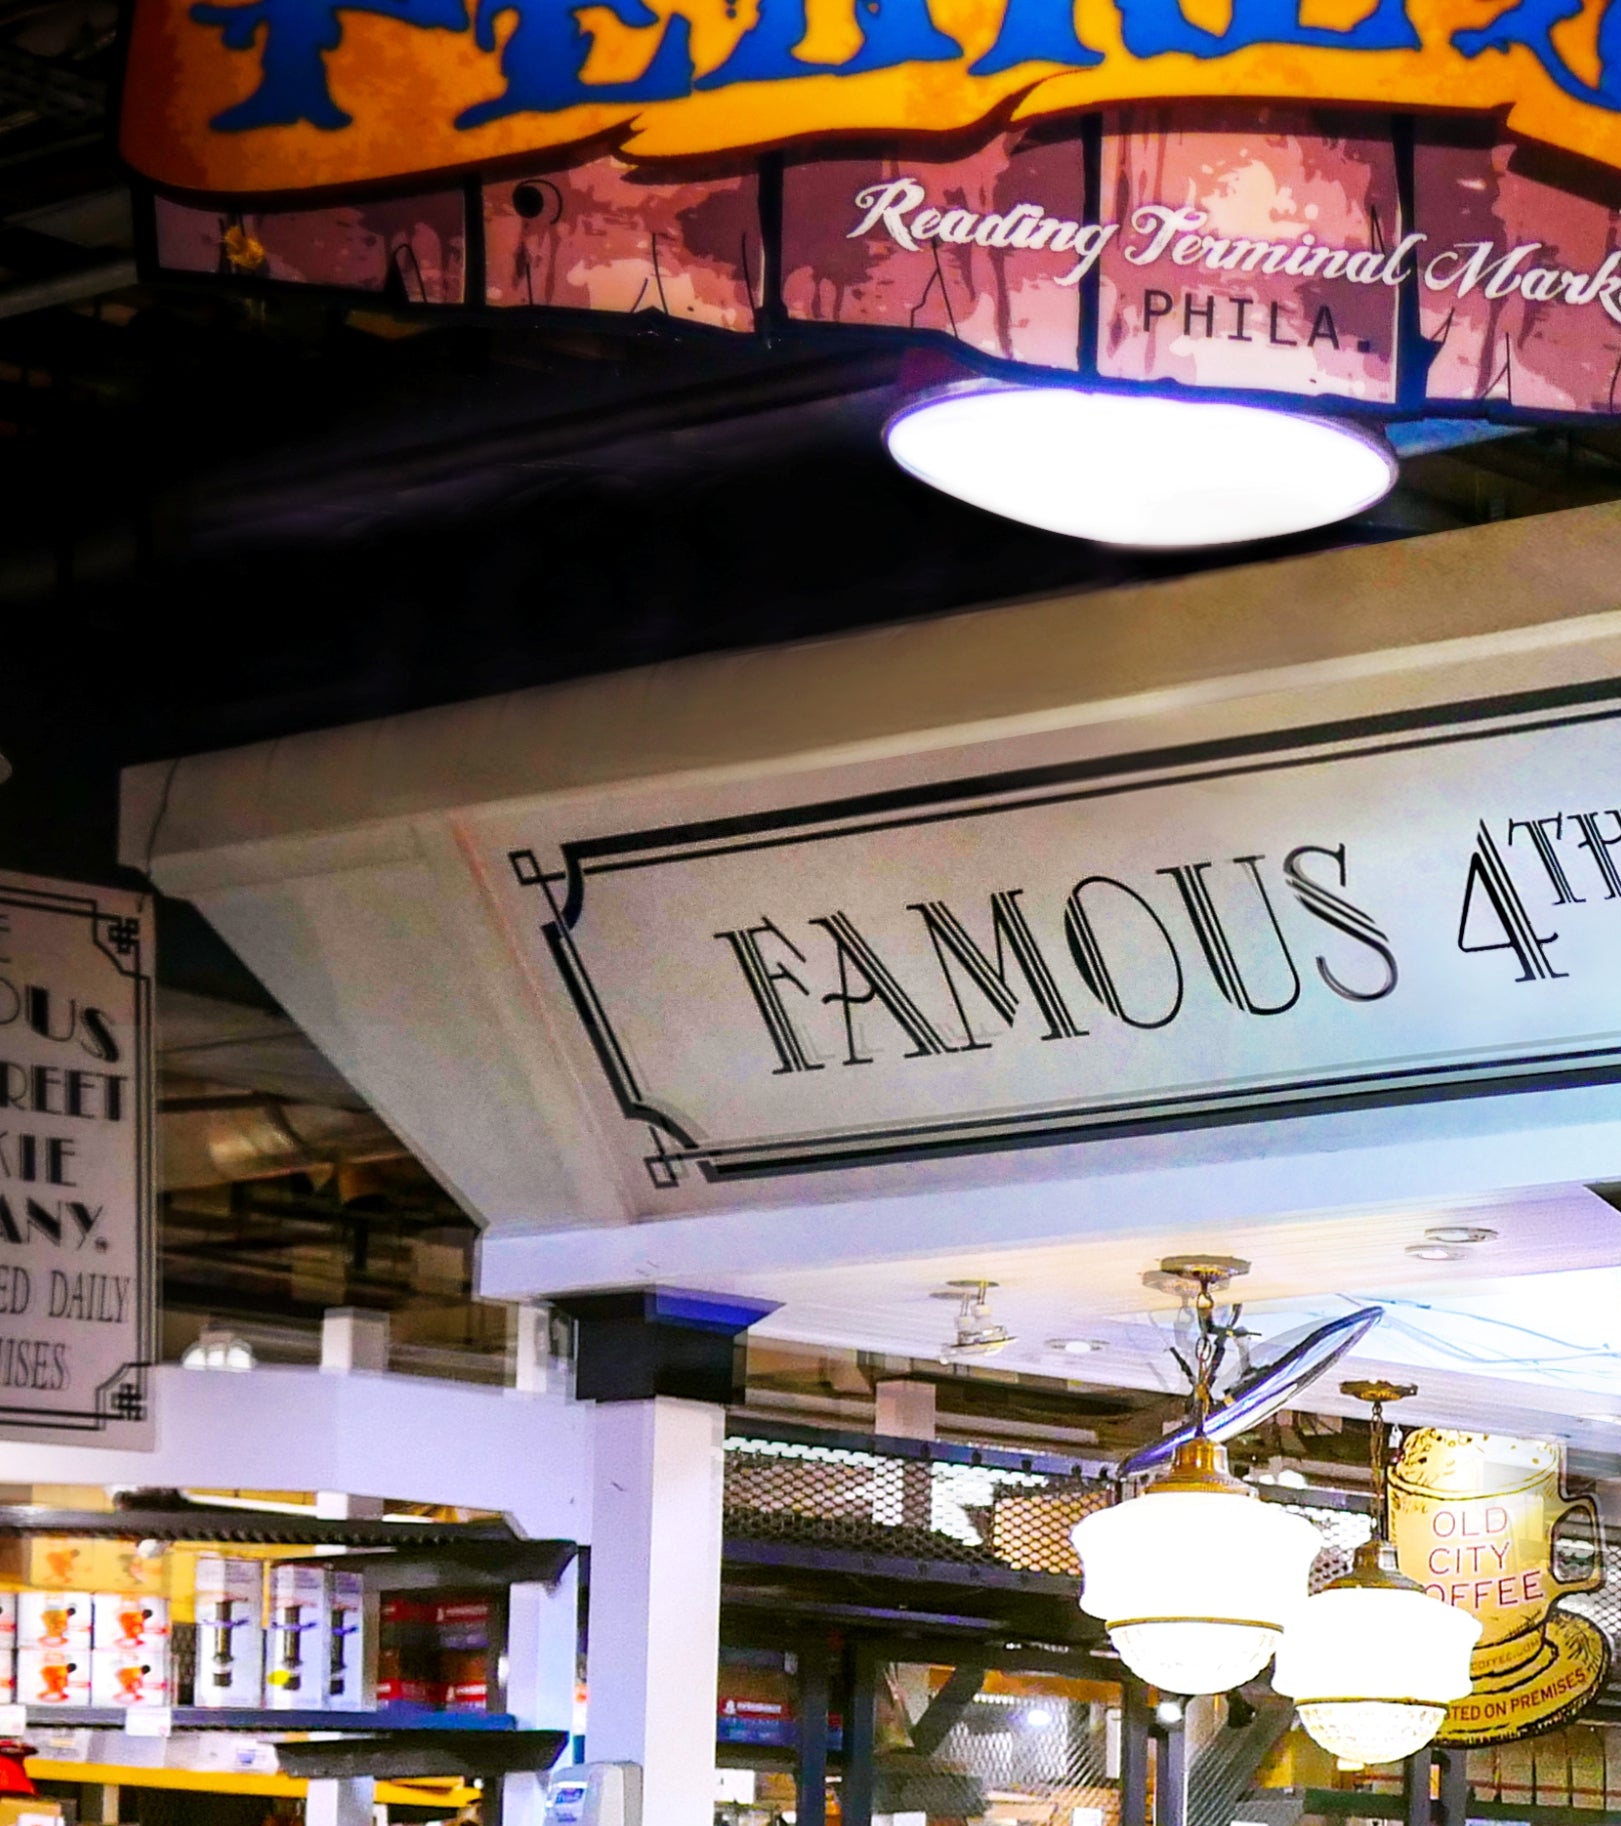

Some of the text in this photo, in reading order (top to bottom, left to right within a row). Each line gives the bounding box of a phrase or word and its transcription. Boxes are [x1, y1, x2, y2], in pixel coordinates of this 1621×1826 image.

[847, 178, 1120, 283] Reading
[1124, 207, 1427, 288] Terminal
[1144, 289, 1373, 353] PHILA.
[714, 844, 1399, 1075] FAMOUS
[0, 1130, 76, 1187] IE
[49, 1270, 130, 1324] DAILY
[0, 1338, 70, 1391] ISES
[1432, 1506, 1508, 1537] OLD
[1429, 1541, 1510, 1574] CITY
[1424, 1570, 1543, 1609] OFFEE
[1485, 1702, 1506, 1719] ON
[1510, 1667, 1586, 1713] PREMISES
